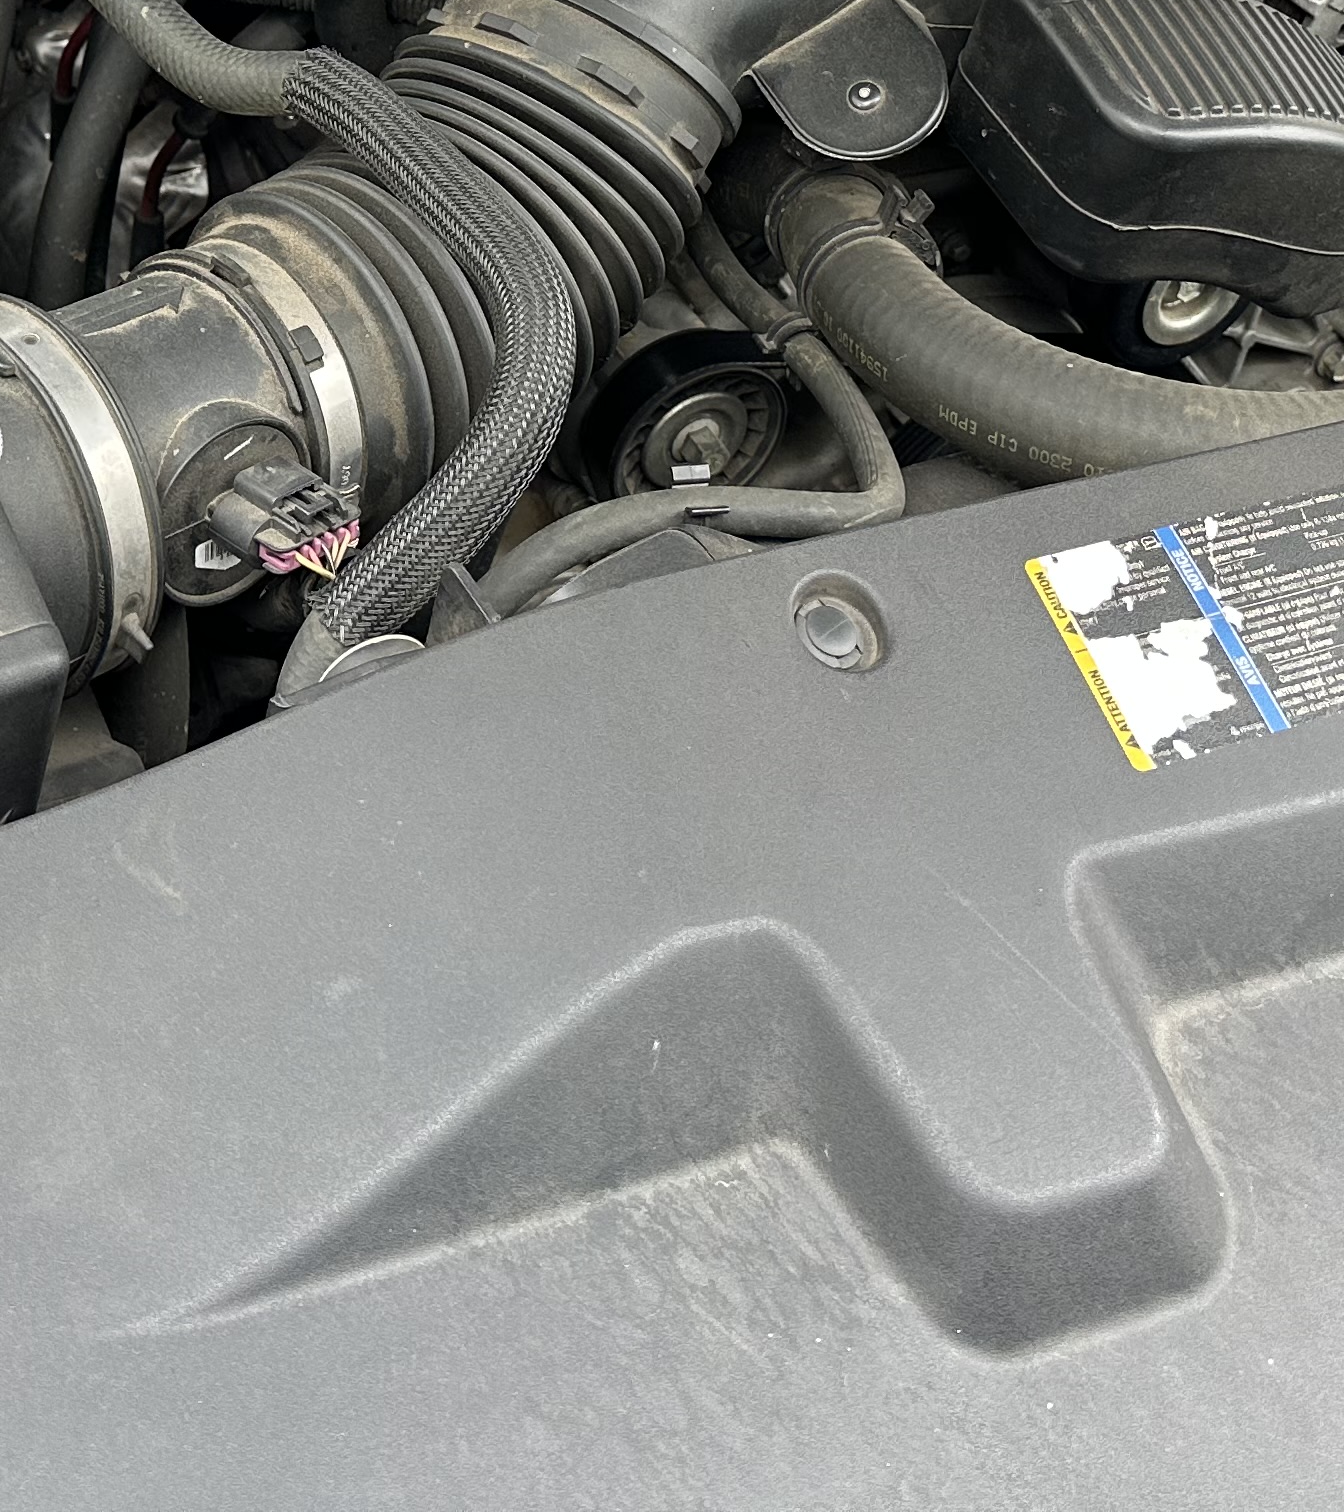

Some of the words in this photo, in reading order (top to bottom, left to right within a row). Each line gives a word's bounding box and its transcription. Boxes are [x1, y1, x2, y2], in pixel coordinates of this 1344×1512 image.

[938, 403, 979, 436] EPDM
[987, 431, 1019, 455] CIP
[1028, 445, 1074, 475] 2300
[1169, 546, 1207, 592] NOTICE
[1035, 569, 1071, 619] CAUTION
[1232, 654, 1262, 688] AVIS
[1086, 667, 1133, 734] ATTENTION
